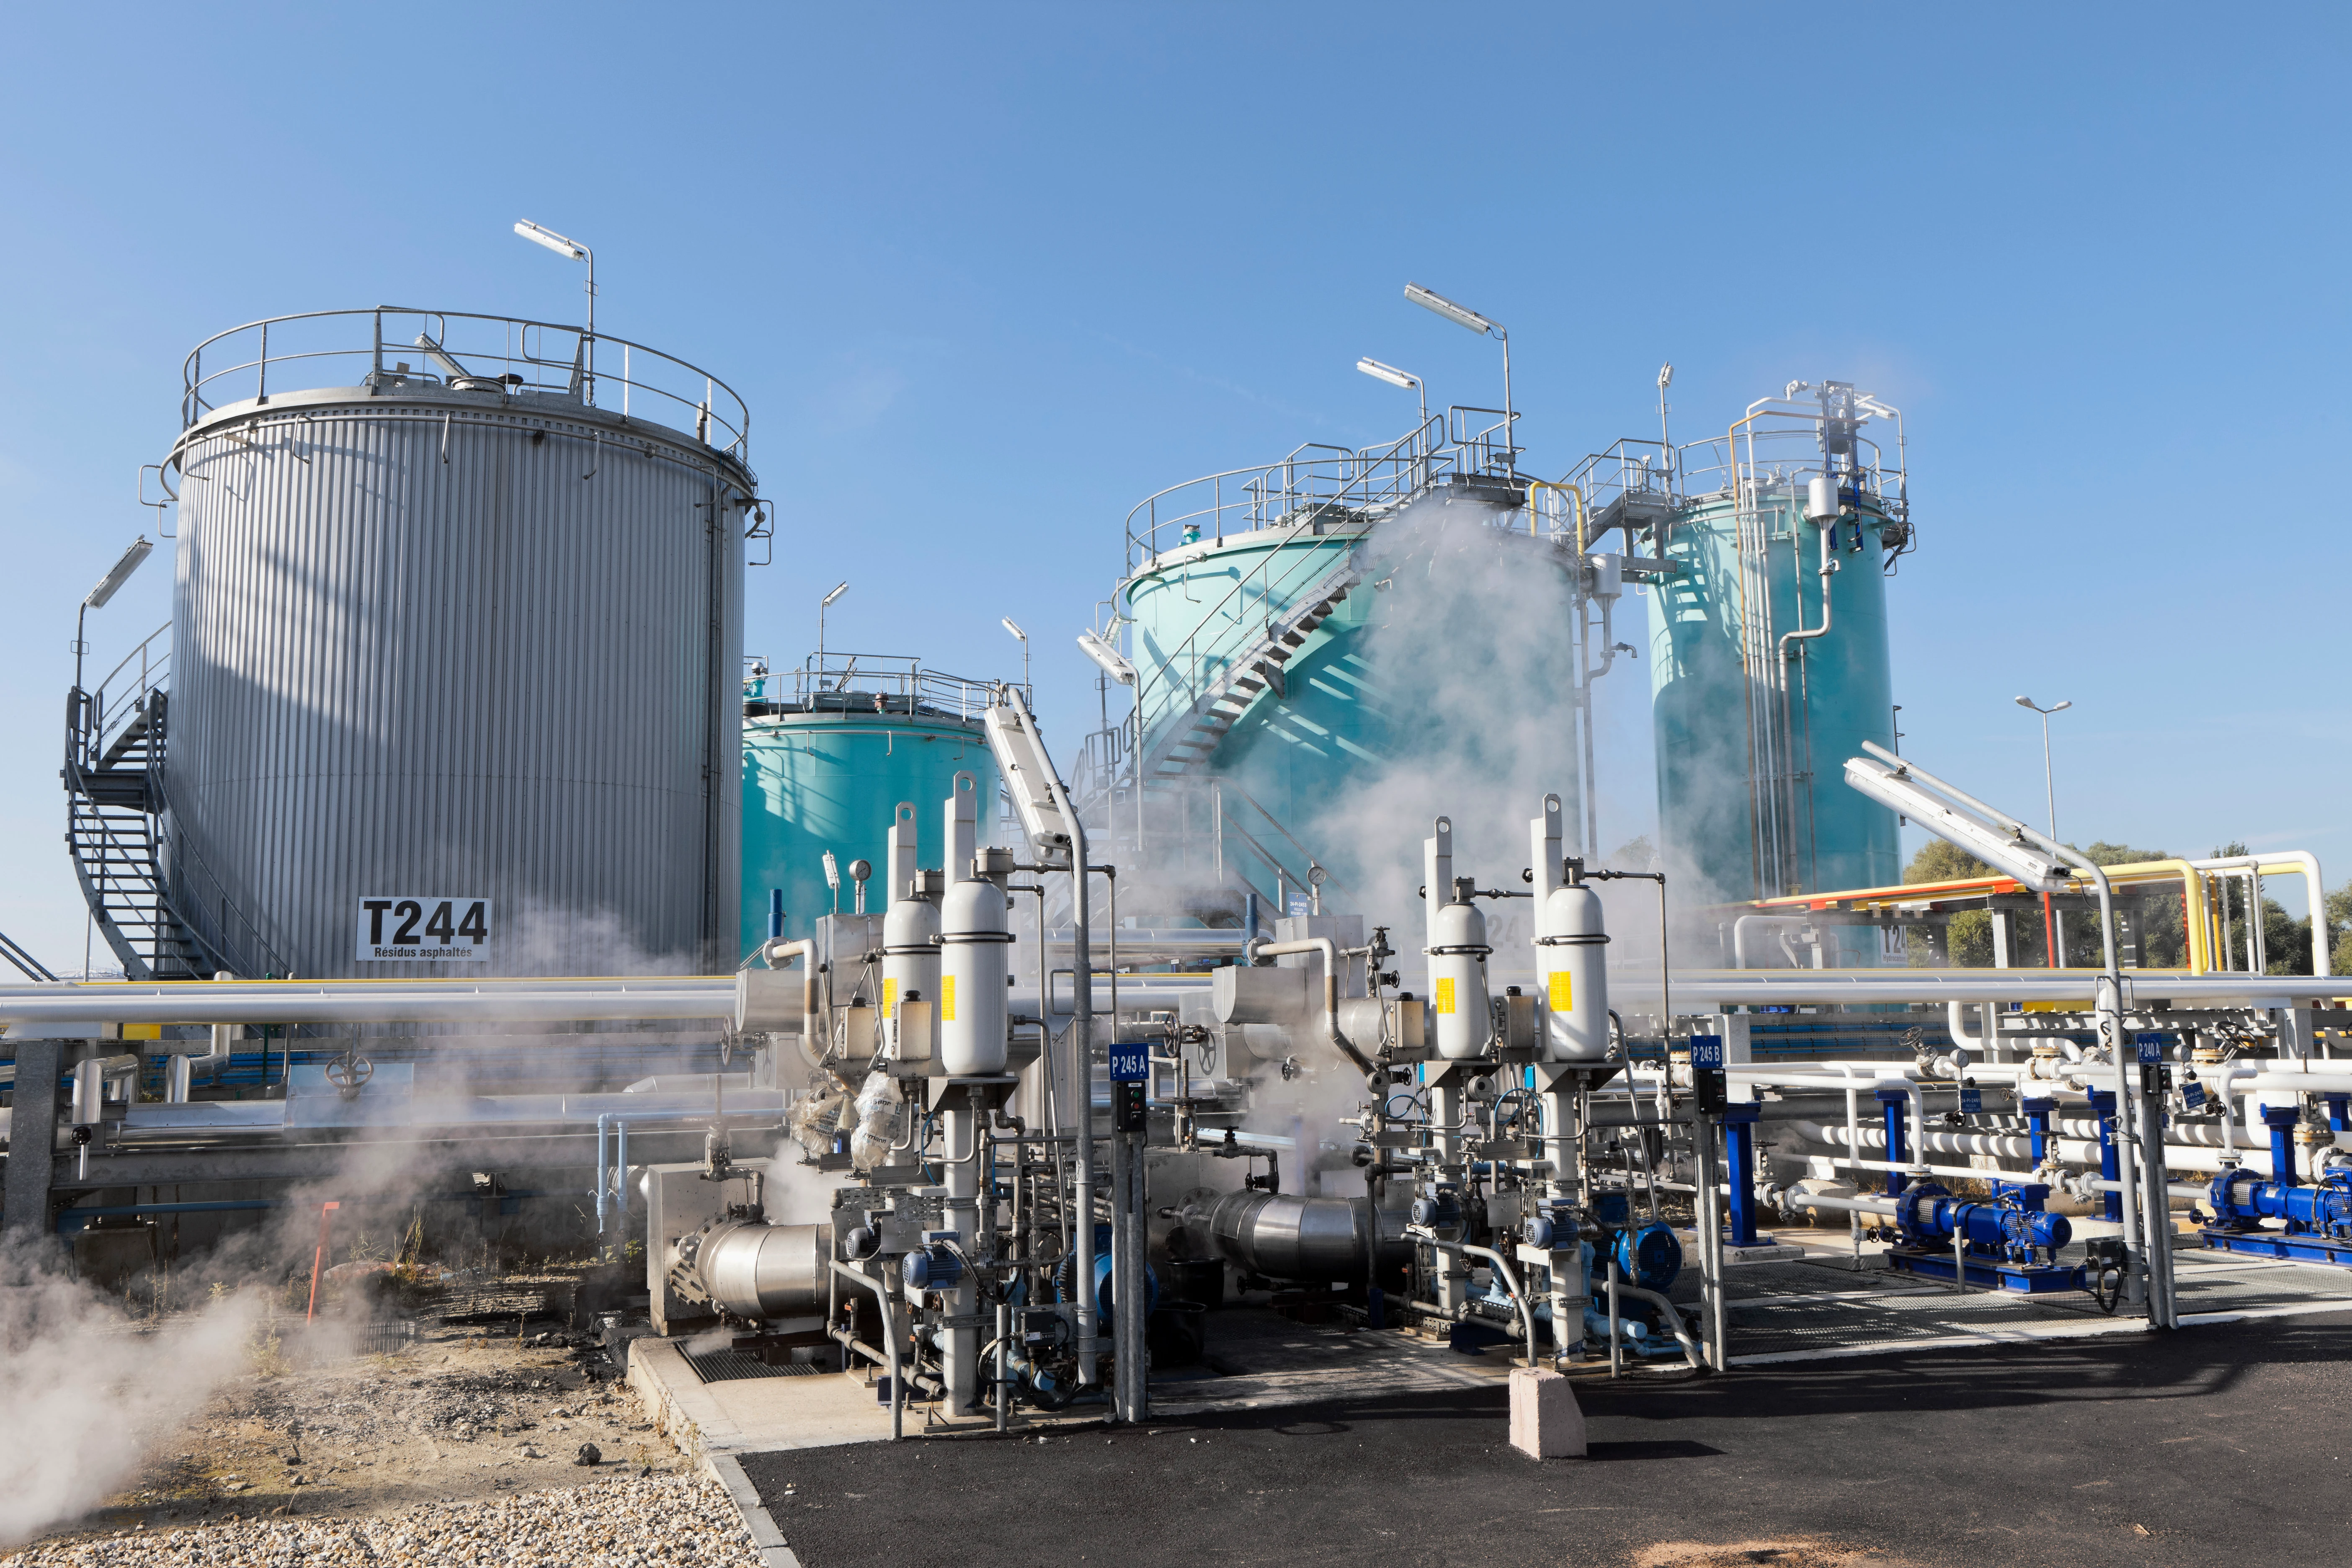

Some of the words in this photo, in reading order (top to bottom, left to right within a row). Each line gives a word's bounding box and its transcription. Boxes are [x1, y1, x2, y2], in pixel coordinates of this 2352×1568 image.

[364, 900, 487, 945] T244
[375, 947, 416, 957] Résidus
[420, 947, 472, 959] asphaltés
[1693, 1046, 1698, 1062] P
[1700, 1046, 1712, 1062] 245
[1714, 1046, 1720, 1061] B
[2138, 1043, 2143, 1057] P
[2144, 1042, 2154, 1057] 240
[2156, 1042, 2161, 1056] A
[1112, 1056, 1118, 1073] P
[1121, 1055, 1137, 1073] 245
[1139, 1055, 1146, 1073] A
